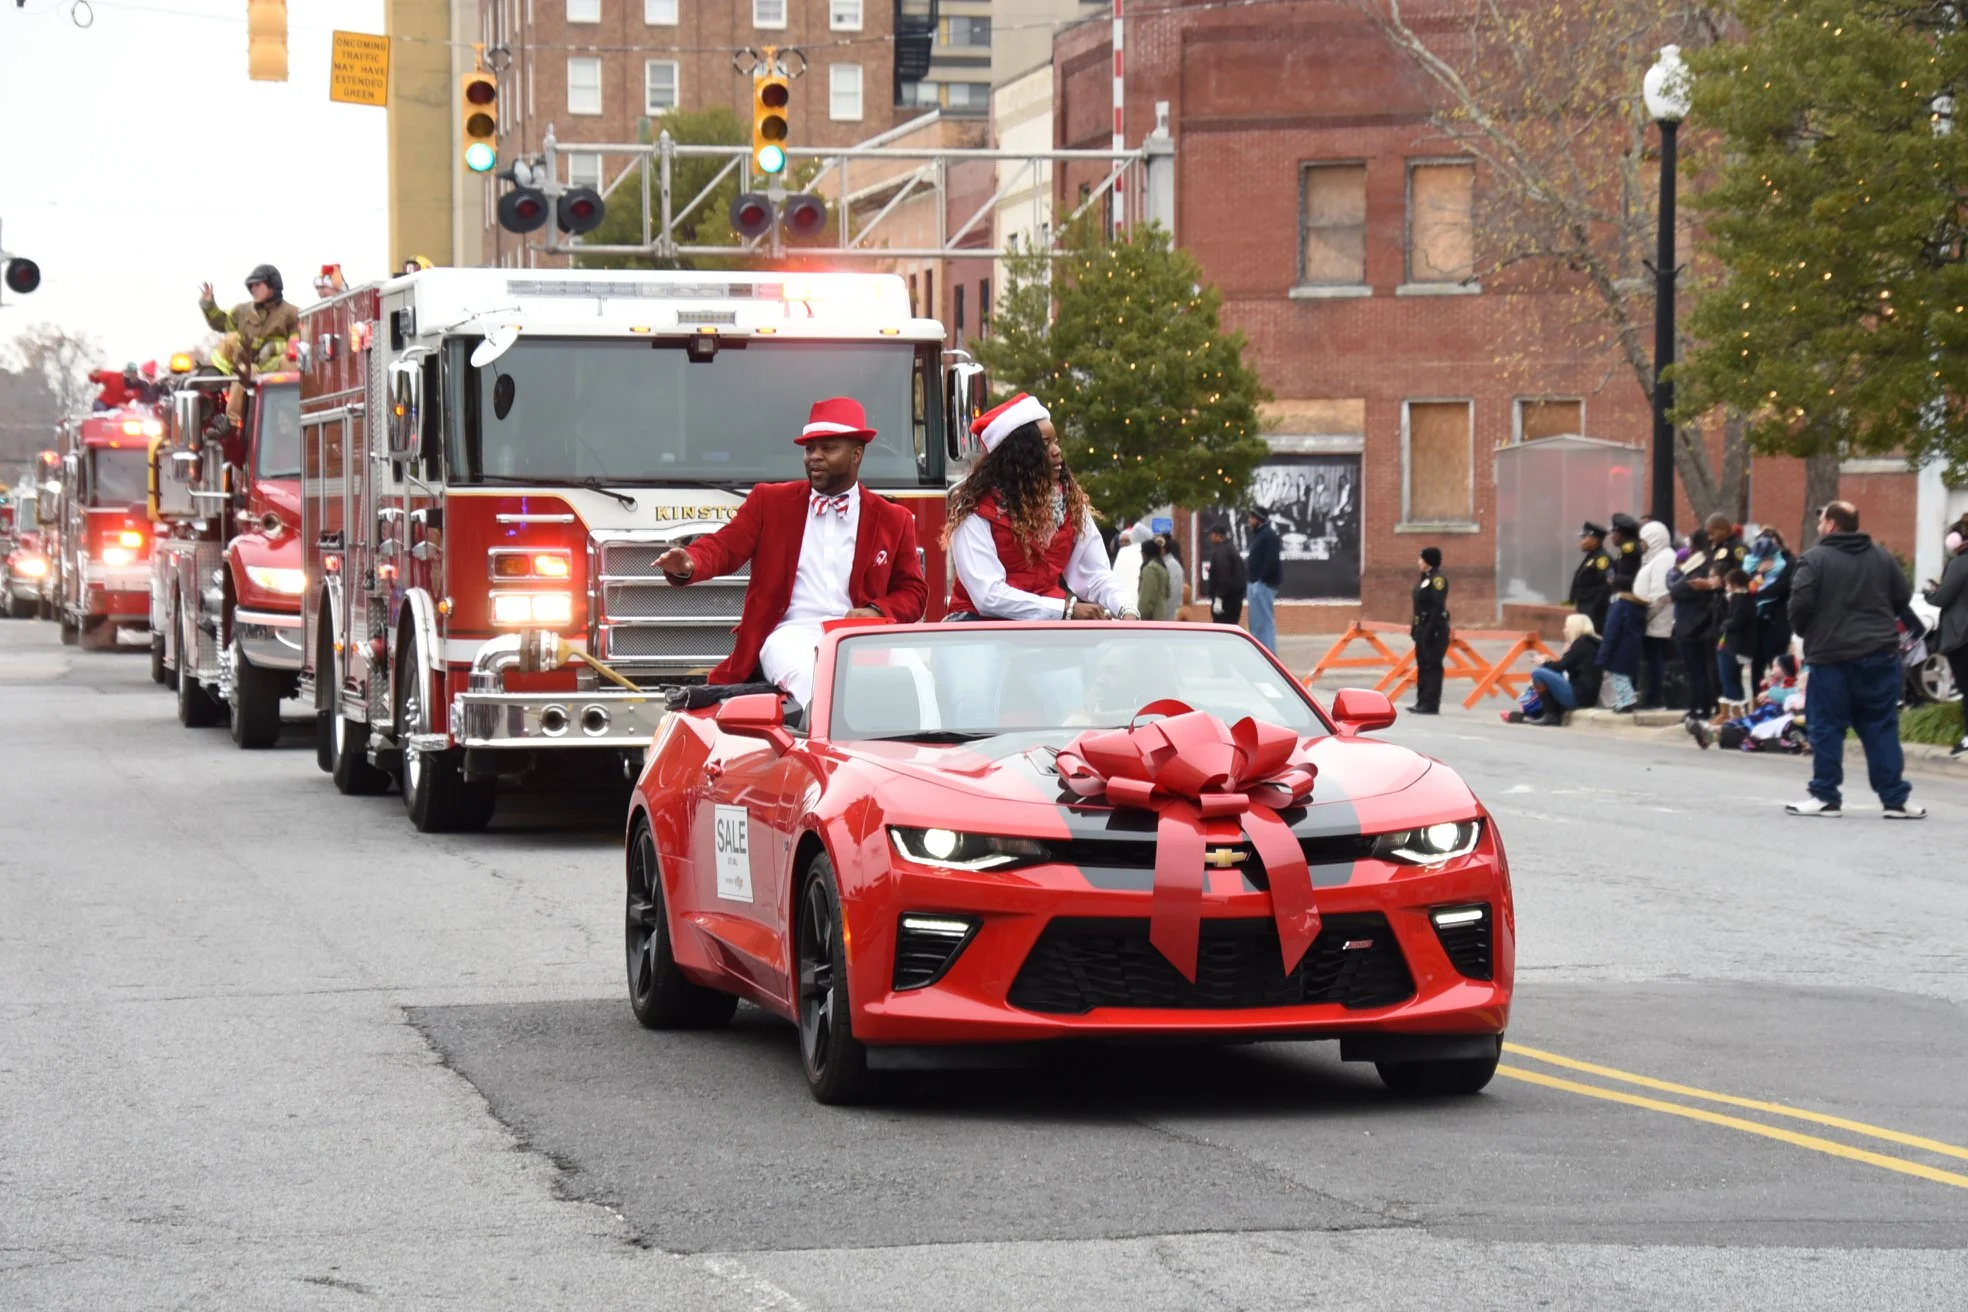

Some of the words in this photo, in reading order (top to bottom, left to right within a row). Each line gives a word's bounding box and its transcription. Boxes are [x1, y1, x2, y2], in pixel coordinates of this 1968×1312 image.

[336, 39, 386, 51] ONCOMING
[342, 51, 380, 62] TRAFFIC
[334, 63, 354, 72] MAY
[361, 66, 385, 76] HAVE
[335, 75, 383, 88] EXTENDED
[344, 88, 375, 99] GREEN
[717, 818, 747, 854] SALE
